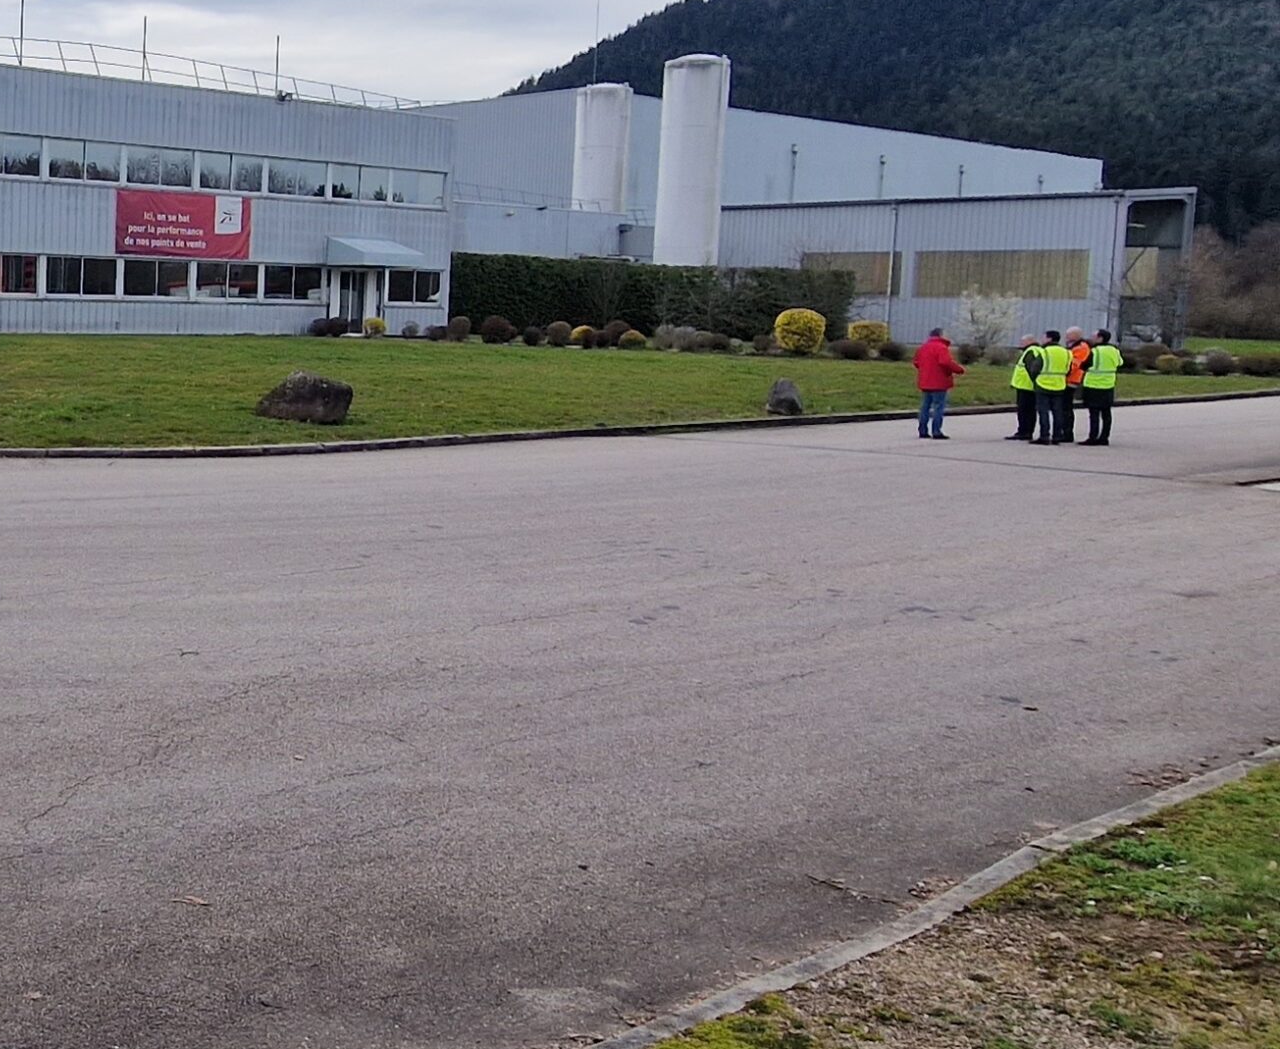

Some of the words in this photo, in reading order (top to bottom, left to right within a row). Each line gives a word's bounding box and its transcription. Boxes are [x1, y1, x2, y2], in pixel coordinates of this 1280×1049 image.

[167, 214, 177, 222] se
[128, 225, 146, 234] pour
[148, 224, 155, 233] la
[156, 226, 203, 236] performance
[124, 235, 134, 245] de
[151, 238, 174, 248] points
[175, 239, 184, 247] de
[186, 240, 206, 248] vente
